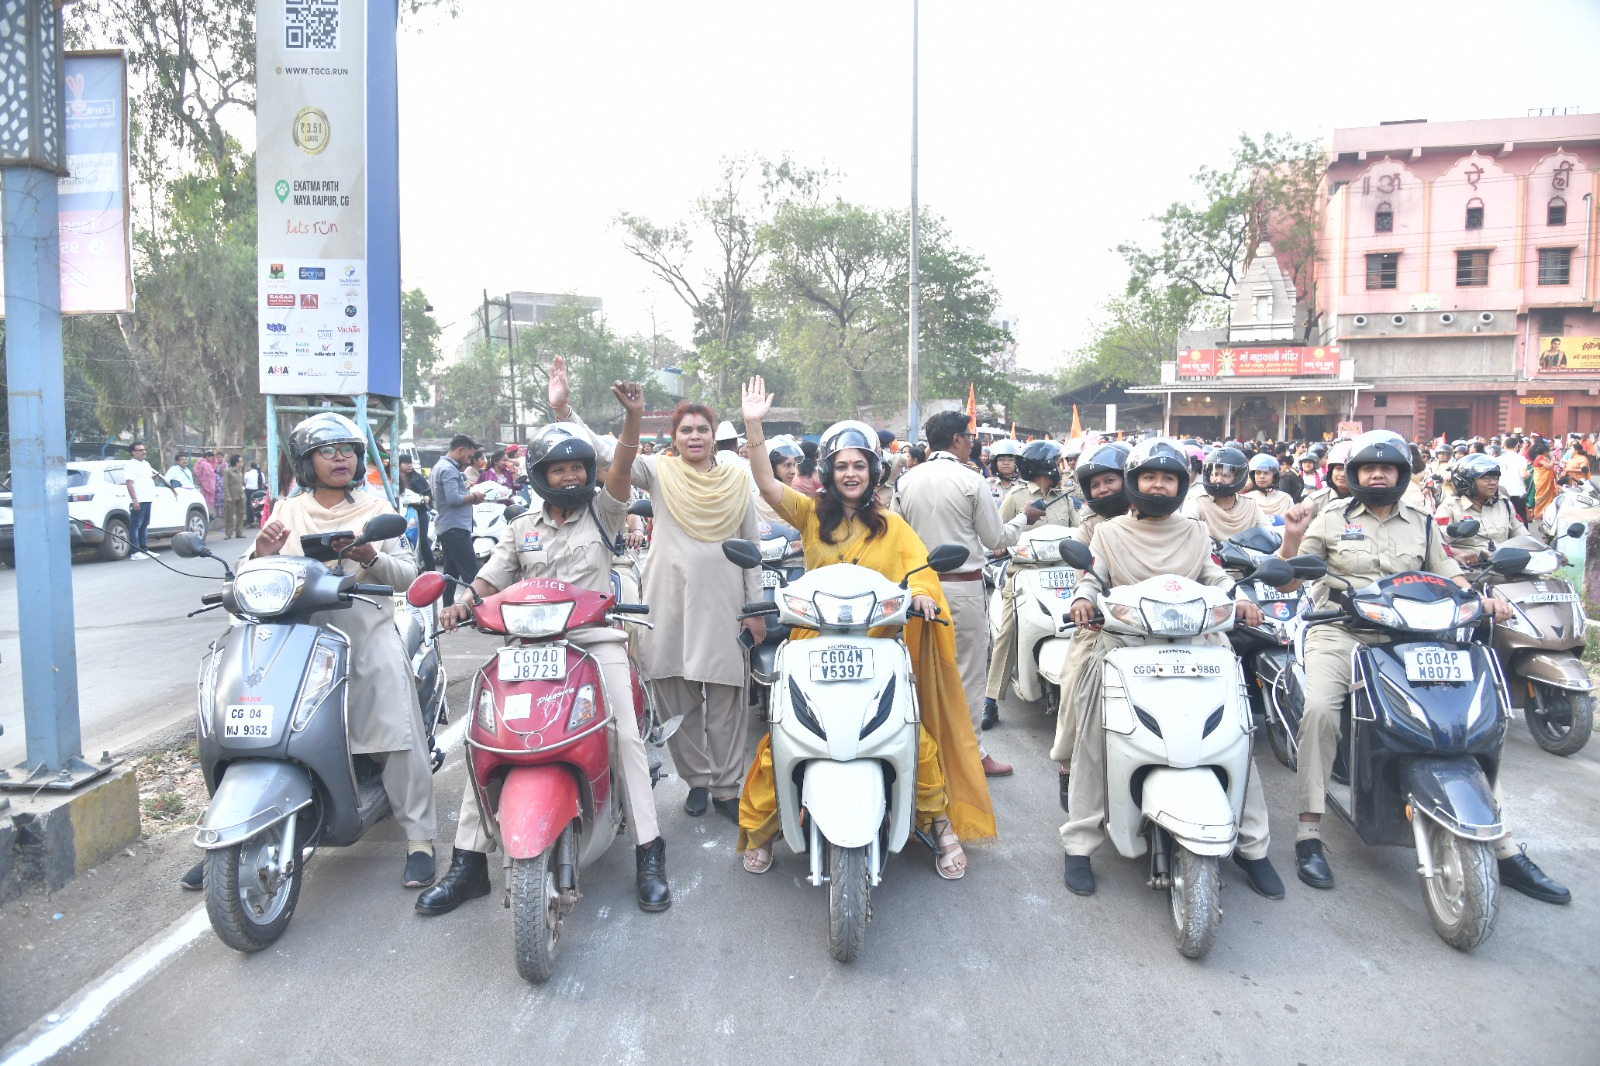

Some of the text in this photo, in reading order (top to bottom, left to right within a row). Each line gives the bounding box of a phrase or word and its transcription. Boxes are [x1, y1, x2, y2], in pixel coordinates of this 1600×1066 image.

[285, 67, 348, 76] WWW.TGCG.RUN
[294, 181, 339, 192] EKATMA PATH
[294, 195, 349, 207] NAYA RAIPUR, CG
[1392, 575, 1446, 588] POLICE
[1416, 653, 1458, 665] CG04P
[514, 664, 558, 678] J8729
[1173, 666, 1185, 674] HZ
[232, 709, 262, 718] CG 04
[226, 725, 267, 735] MJ 9352
